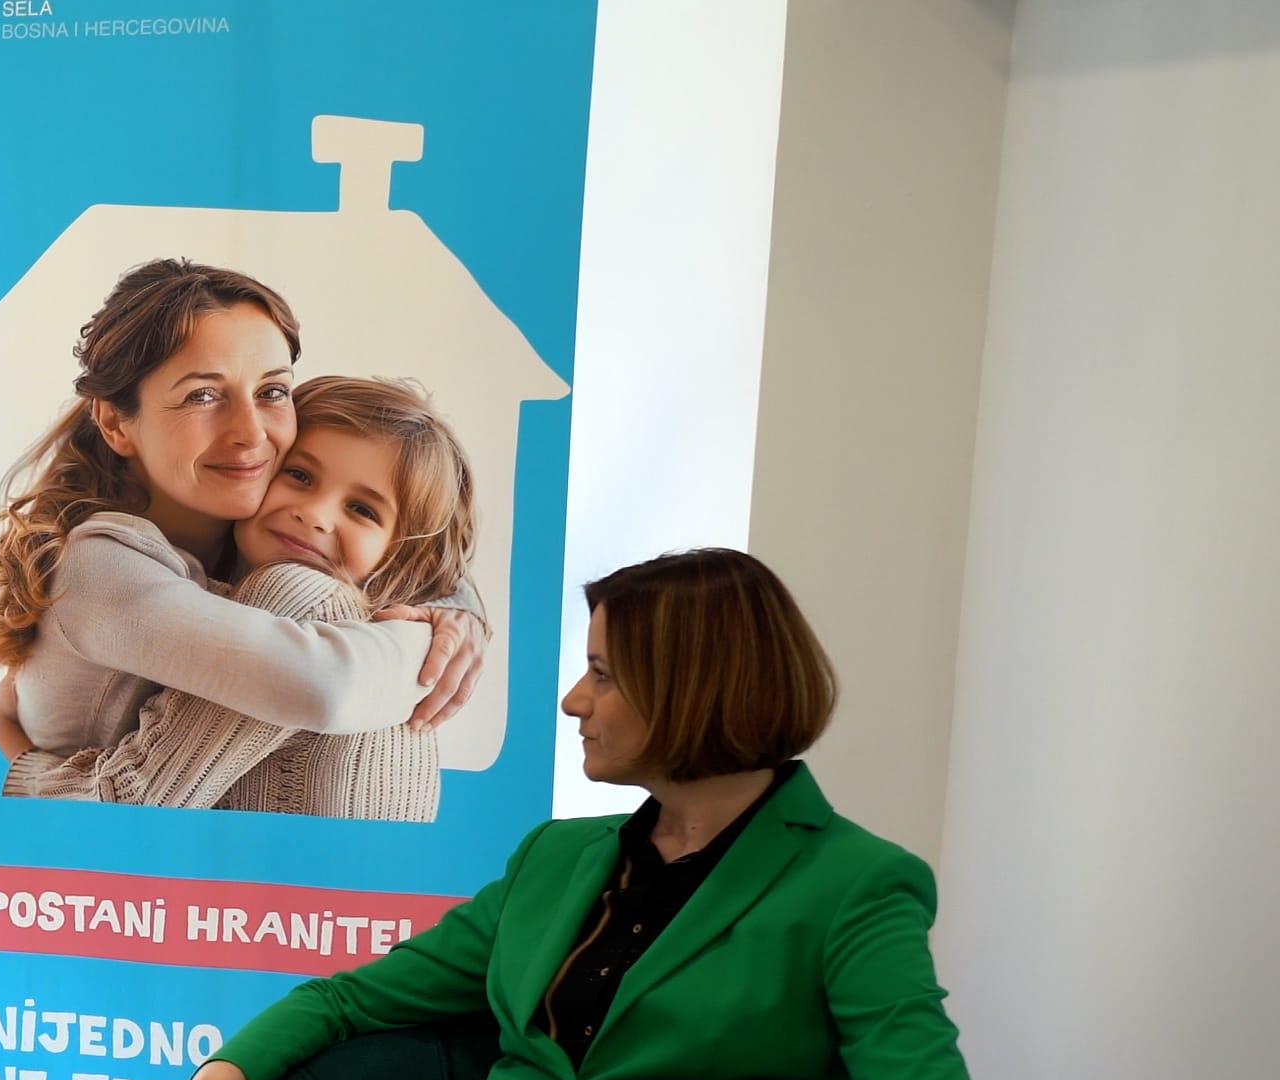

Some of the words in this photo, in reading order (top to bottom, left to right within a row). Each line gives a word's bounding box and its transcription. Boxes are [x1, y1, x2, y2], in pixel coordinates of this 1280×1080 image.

[1, 0, 53, 17] SELA
[1, 22, 69, 40] BOSNA
[73, 22, 79, 37] I
[84, 17, 231, 38] HERCEGOVINA
